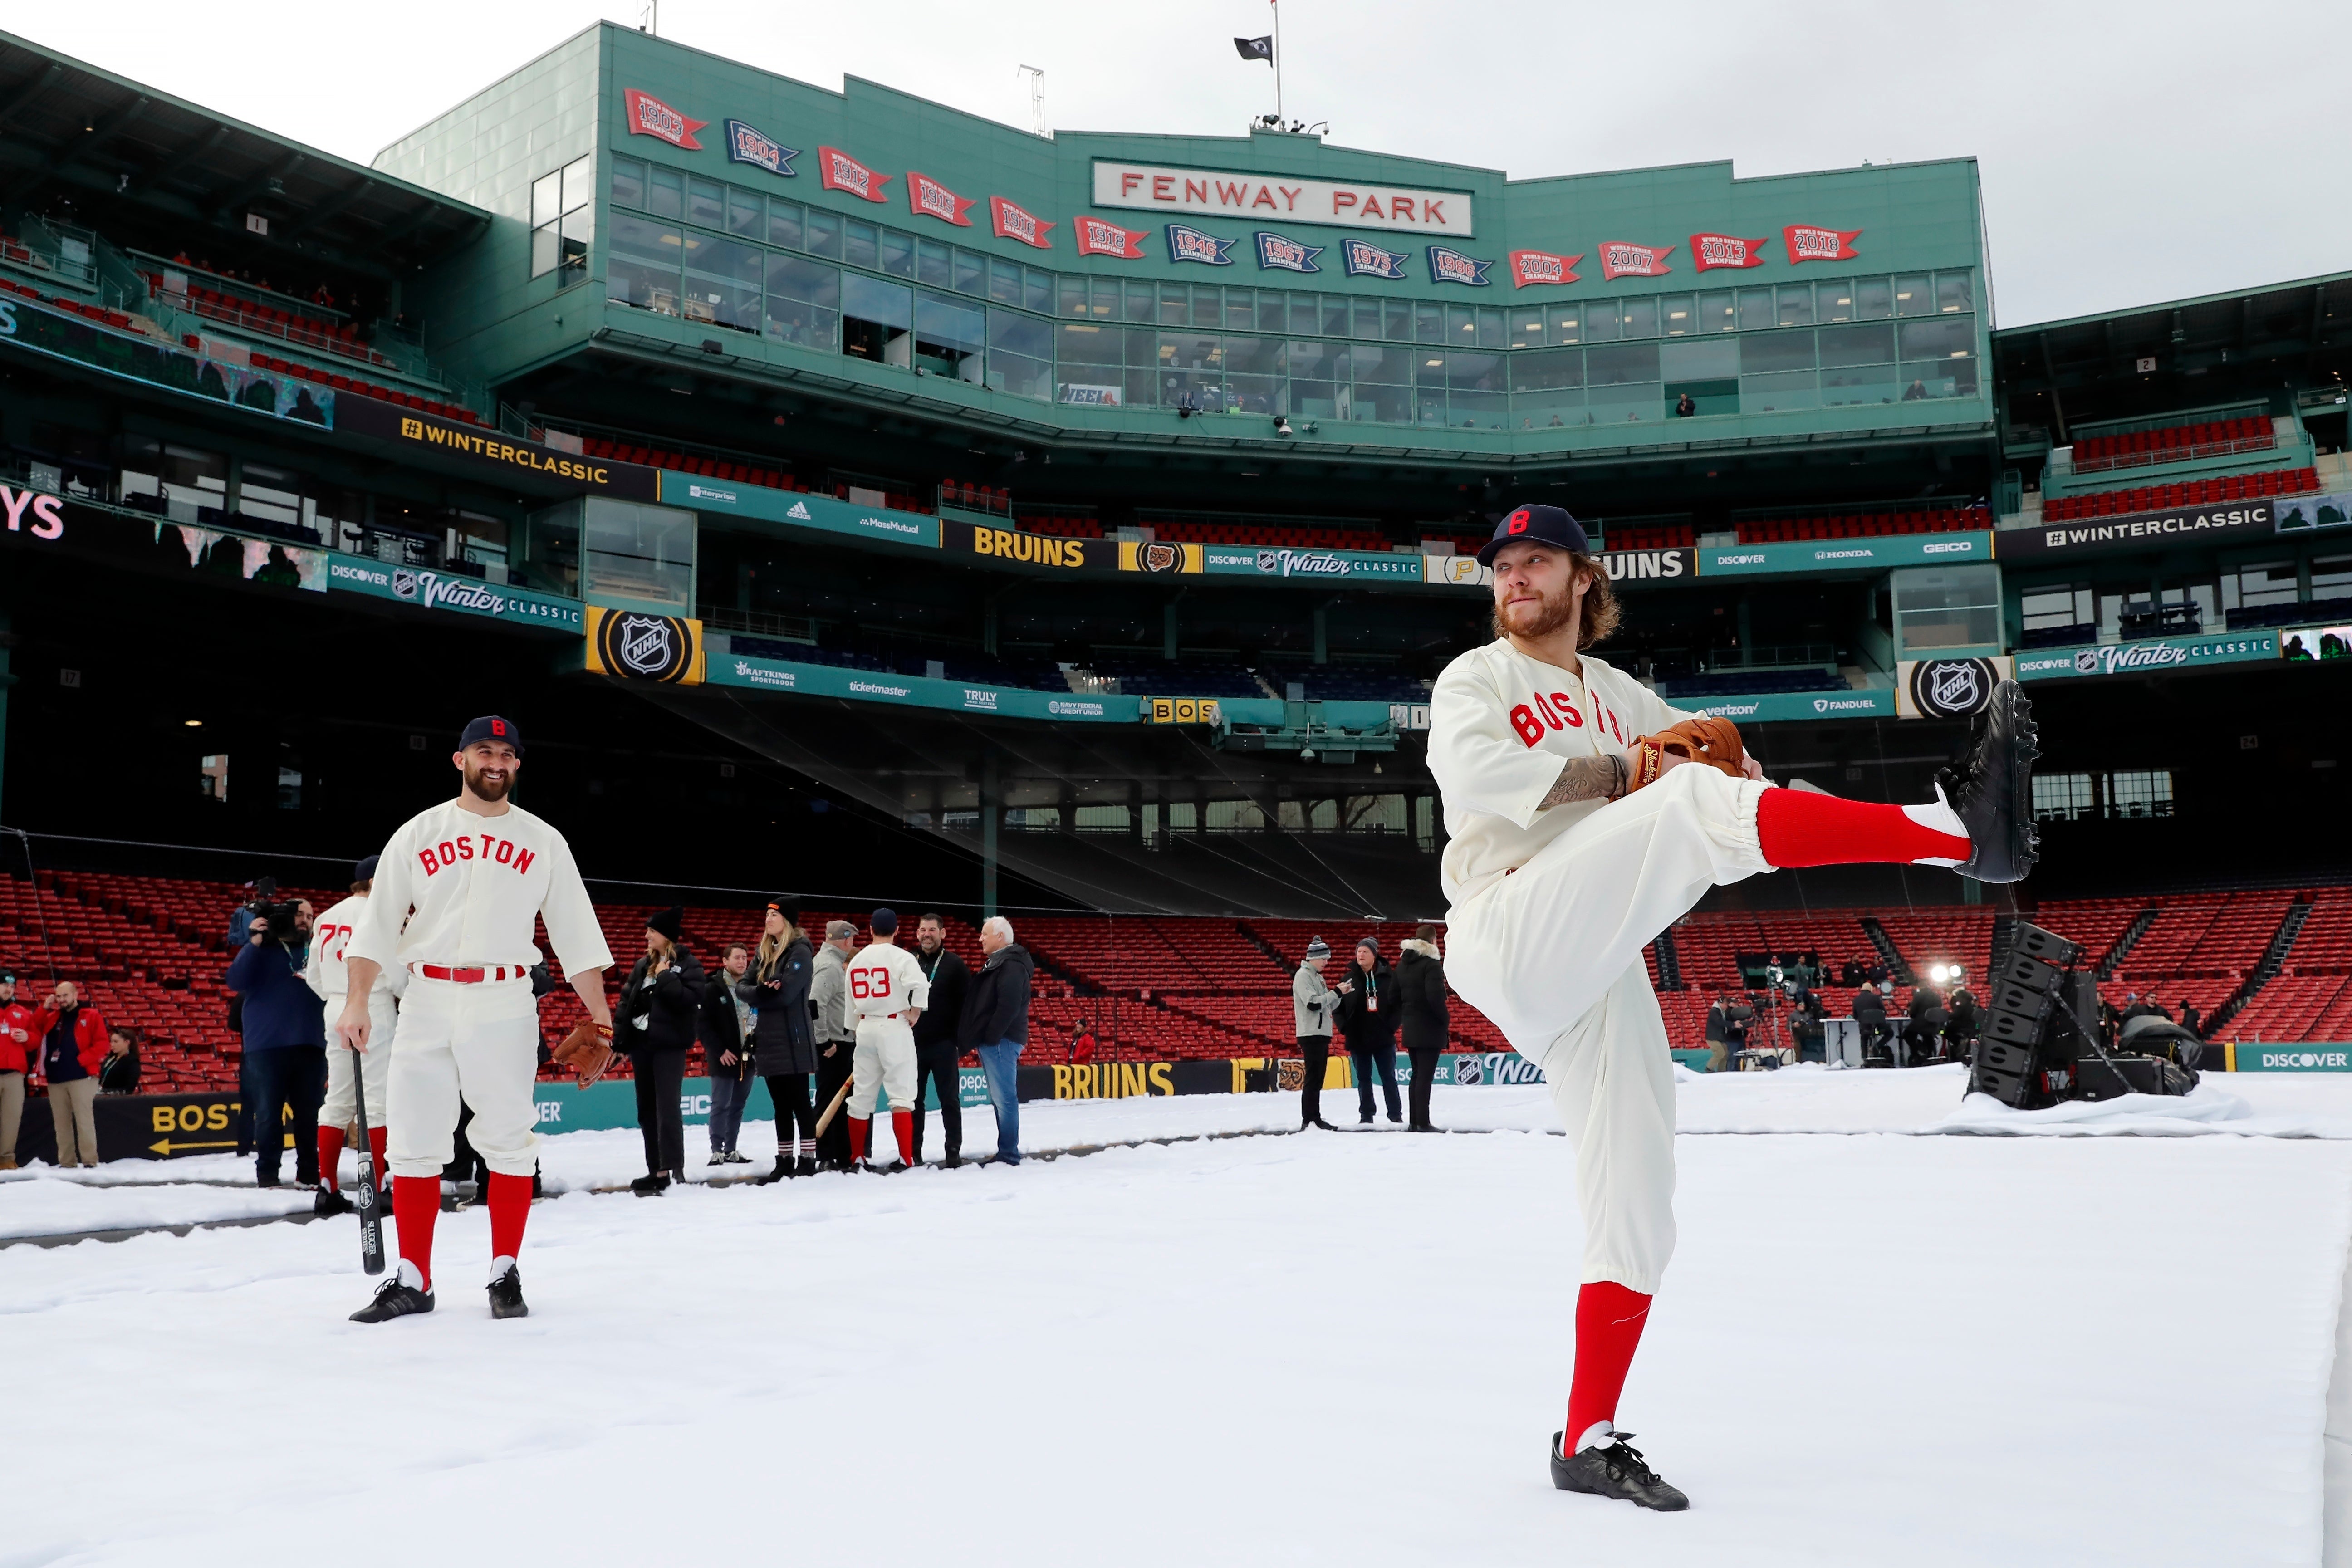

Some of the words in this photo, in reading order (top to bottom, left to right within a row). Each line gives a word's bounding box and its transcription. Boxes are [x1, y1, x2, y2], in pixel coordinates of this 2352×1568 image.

[639, 97, 661, 109] WORLD
[662, 104, 682, 121] SERIES
[639, 104, 683, 136] 1903
[642, 121, 680, 142] CHAMPIONS
[737, 132, 779, 164] 1904
[741, 149, 777, 169] CHAMPIONS
[832, 153, 851, 165] WORLD
[851, 162, 869, 176] SERIES
[833, 161, 869, 189] 1912
[833, 176, 868, 196] CHAMPIONS
[919, 178, 937, 190] WORLD
[938, 186, 955, 201] SERIES
[920, 186, 955, 214] 1915
[1122, 173, 1302, 210] FENWAY
[1333, 191, 1446, 223] PARK
[921, 201, 954, 220] CHAMPIONS
[1002, 202, 1019, 214] WORLD
[1019, 211, 1036, 223] SERIES
[1003, 210, 1035, 236] 1916
[1087, 221, 1107, 230] WORLD
[1107, 225, 1126, 236] SERIES
[1004, 225, 1034, 243] CHAMPIONS
[1088, 227, 1125, 248] 1918
[1794, 235, 1840, 251] 2018
[1090, 242, 1124, 255] CHAMPIONS
[1177, 234, 1217, 256] 1946
[1265, 242, 1305, 264] 1967
[1702, 244, 1746, 260] 2013
[1799, 250, 1838, 258] CHAMPIONS
[1180, 249, 1215, 262] CHAMPIONS
[1269, 257, 1302, 270] CHAMPIONS
[1353, 248, 1391, 271] 1975
[1608, 251, 1653, 268] 2007
[1706, 257, 1744, 266] CHAMPIONS
[1356, 263, 1389, 276] CHAMPIONS
[1437, 255, 1475, 277] 1986
[1520, 260, 1562, 275] 2004
[1441, 270, 1473, 283] CHAMPIONS
[2143, 360, 2149, 371] 2
[404, 418, 608, 484] #WINTERCLASSIC
[787, 511, 811, 520] adidas
[1508, 510, 1530, 535] B
[870, 518, 919, 534] MassMutual
[2048, 508, 2267, 546] #WINTERCLASSIC
[975, 526, 1085, 568] BRUINS
[1826, 550, 1874, 559] HONDA
[1923, 542, 1972, 554] GEICO
[1209, 555, 1254, 566] DISCOVER
[1260, 555, 1274, 567] NHL
[1277, 549, 1350, 577] Winter
[1353, 561, 1417, 573] CLASSIC
[1717, 554, 1765, 565] DISCOVER
[331, 564, 388, 586] DISCOVER
[397, 577, 412, 592] NHL
[418, 571, 505, 615] Winter
[508, 599, 579, 623] CLASSIC
[632, 633, 661, 658] NHL
[2020, 659, 2071, 672] DISCOVER
[2079, 656, 2094, 669] NHL
[2098, 642, 2187, 674] Winter
[2191, 640, 2271, 657] CLASSIC
[66, 671, 75, 684] 17
[737, 667, 795, 681] DRAFTKINGS
[750, 676, 794, 687] SPORTSBOOK
[849, 681, 908, 697] ticketmaster
[964, 690, 997, 702] TRULY
[1942, 675, 1969, 701] NHL
[1706, 704, 1754, 716] verizon
[1830, 699, 1875, 710] FANDUEL
[492, 720, 505, 736] B
[2243, 738, 2255, 748] 24
[1644, 746, 1658, 782] Shoeless
[419, 834, 535, 876] BOSTON
[850, 968, 890, 999] 63
[2262, 1052, 2348, 1068] DISCOVER
[1051, 1062, 1174, 1100] BRUINS
[1460, 1065, 1479, 1082] NHL
[959, 1075, 987, 1094] peps
[681, 1095, 712, 1115] EIC
[367, 1220, 376, 1256] SLUGGER
